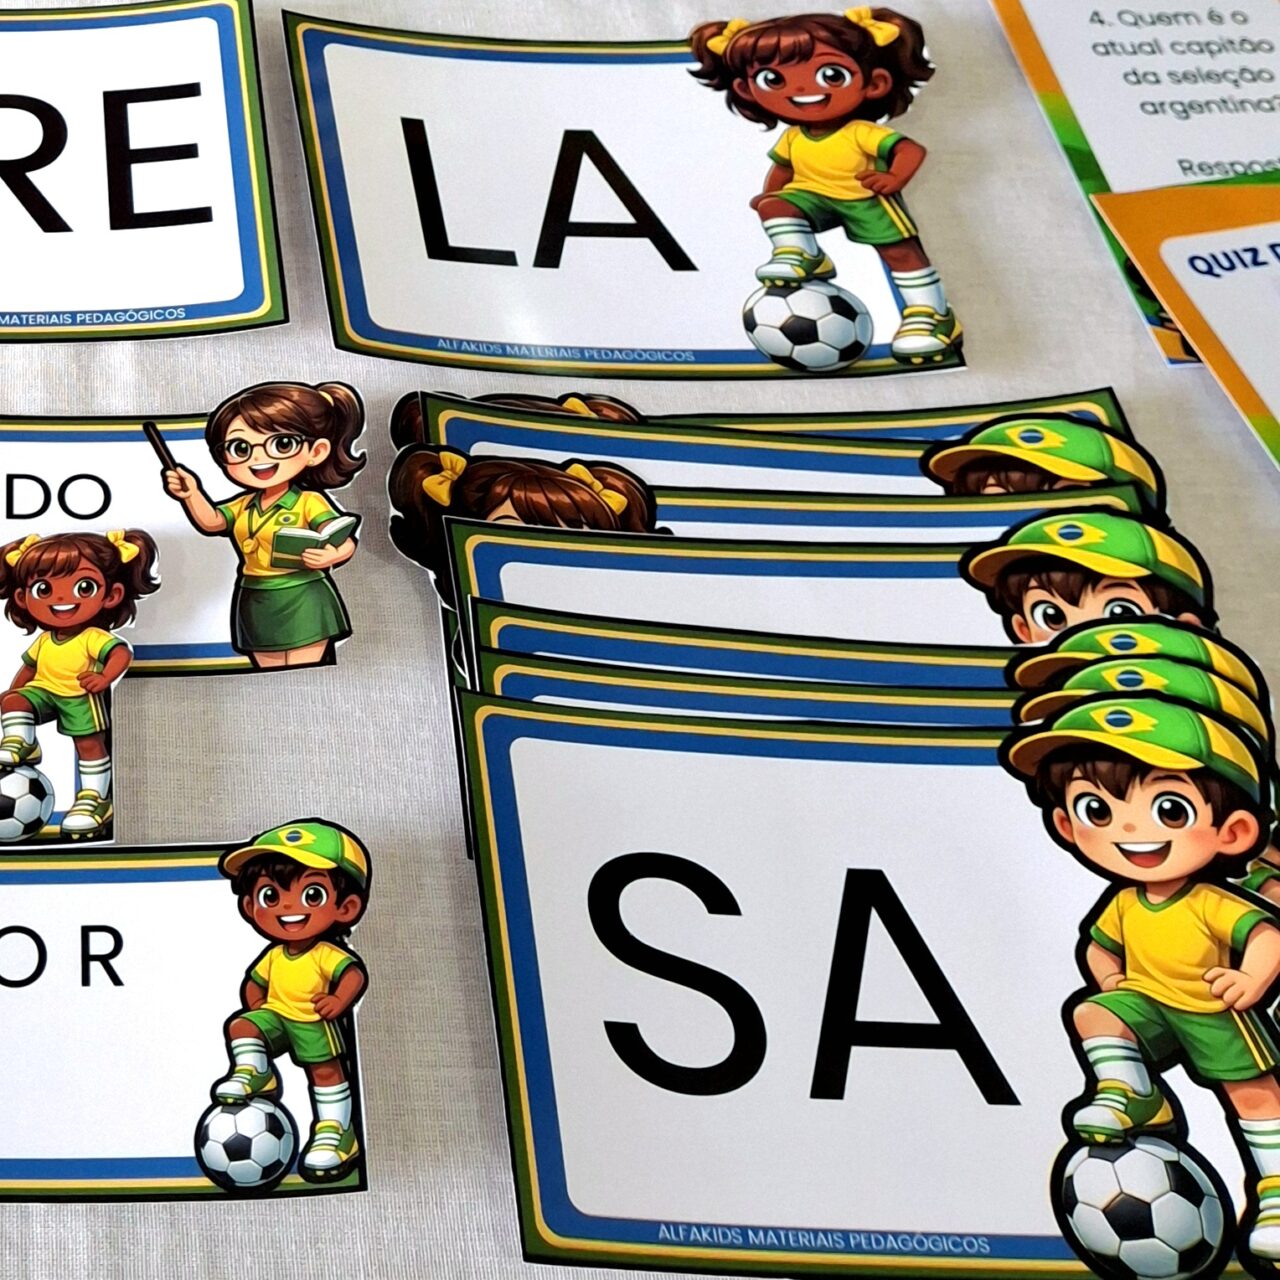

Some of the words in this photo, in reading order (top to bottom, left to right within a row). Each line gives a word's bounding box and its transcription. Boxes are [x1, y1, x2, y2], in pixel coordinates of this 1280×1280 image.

[1117, 9, 1201, 29] Quem
[1207, 7, 1224, 25] é
[1230, 10, 1249, 25] o
[1092, 38, 1164, 56] atual
[1170, 38, 1275, 59] capitão
[1123, 67, 1161, 85] da
[1167, 67, 1275, 88] seleção
[401, 117, 699, 272] LA
[1188, 247, 1269, 278] QUIZ
[76, 308, 186, 323] PEDAGÓGICOS
[6, 474, 111, 520] DO
[587, 852, 1021, 1107] SA
[658, 1223, 742, 1244] ALFAKIDS
[748, 1226, 844, 1249] MATERIAIS
[850, 1230, 991, 1254] PEDAGÓGICOS
